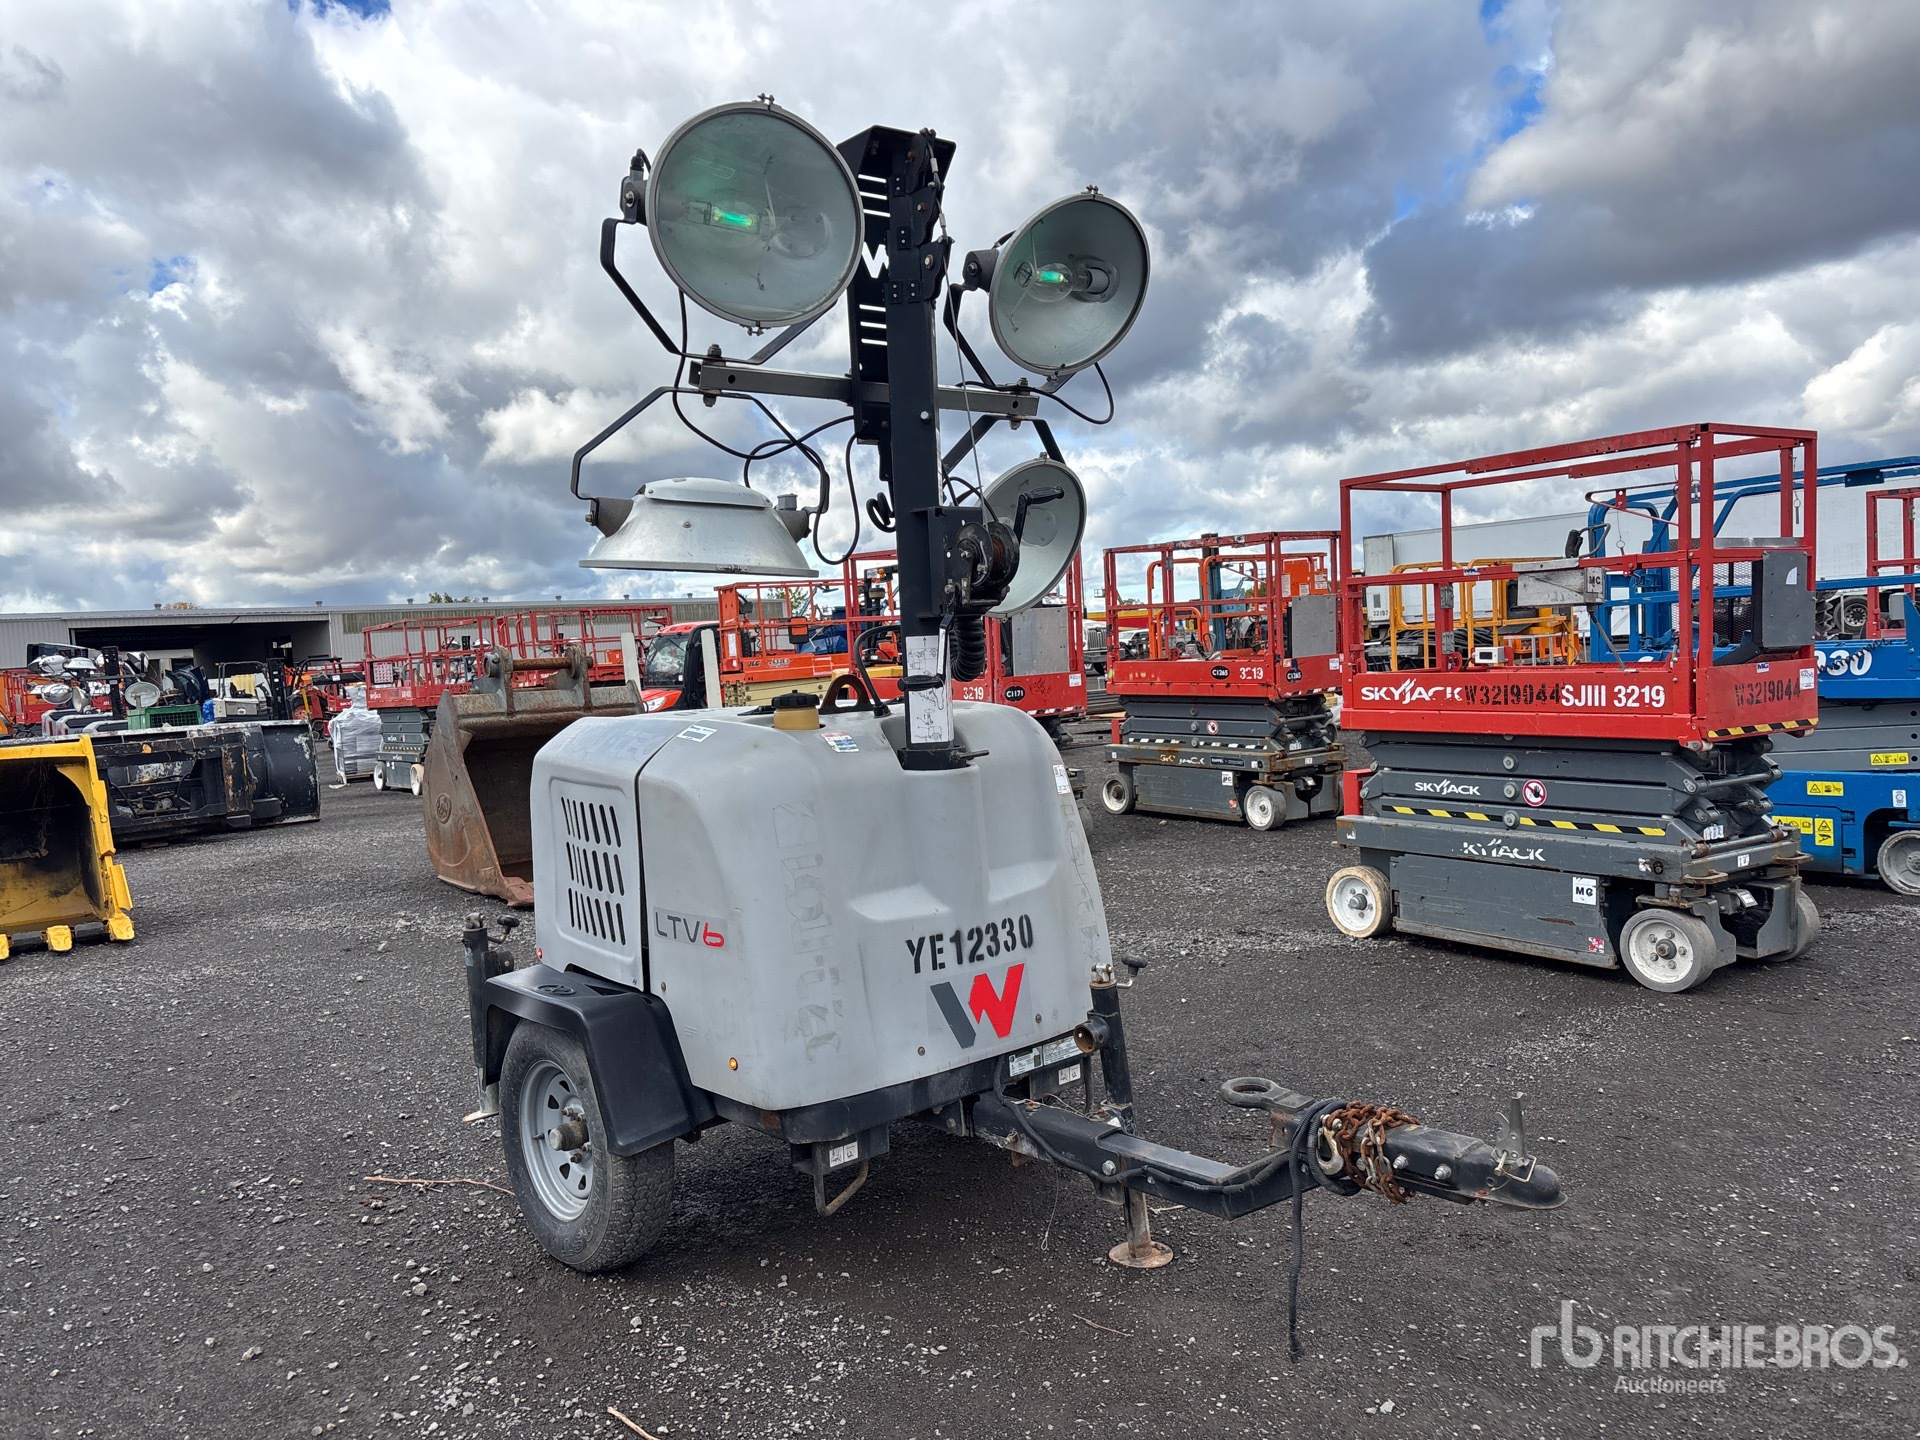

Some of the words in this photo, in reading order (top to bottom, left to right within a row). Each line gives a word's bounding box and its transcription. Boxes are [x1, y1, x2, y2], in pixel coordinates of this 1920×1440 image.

[963, 686, 985, 700] 3219
[1613, 685, 1666, 708] 3219
[1414, 779, 1482, 796] SKYJACK
[905, 914, 1034, 974] YE12330
